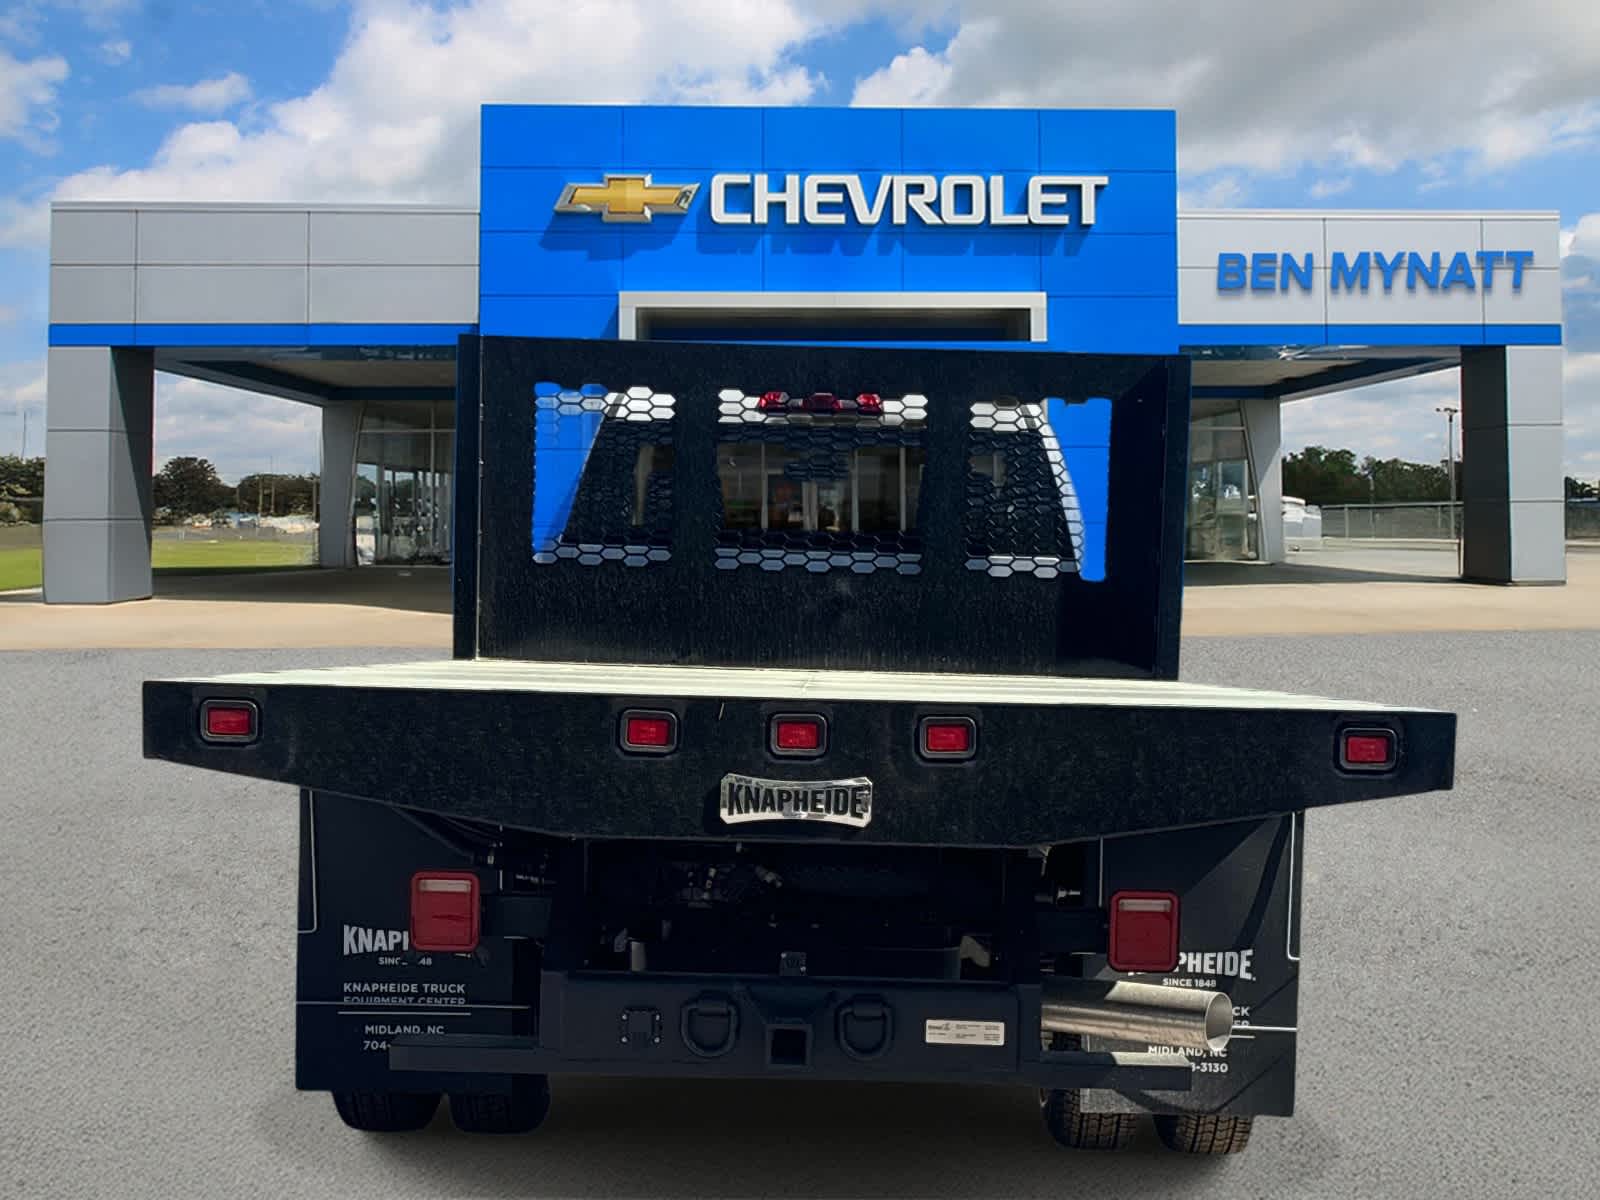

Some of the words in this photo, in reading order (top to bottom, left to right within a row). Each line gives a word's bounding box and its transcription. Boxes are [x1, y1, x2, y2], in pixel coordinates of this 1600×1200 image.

[709, 173, 1109, 226] CHEVROLET
[1218, 252, 1313, 291] BEN
[1330, 251, 1534, 291] MYNATT
[727, 783, 865, 818] KNAPHEIDE
[378, 957, 409, 966] SINC
[343, 982, 418, 993] KNAPHEIDE
[422, 983, 466, 994] TRUCK
[1162, 977, 1193, 987] SINCE
[1194, 978, 1217, 988] 1848
[427, 1025, 445, 1035] NC
[363, 1040, 391, 1051] 704-
[1148, 1046, 1207, 1057] MIDLAND,
